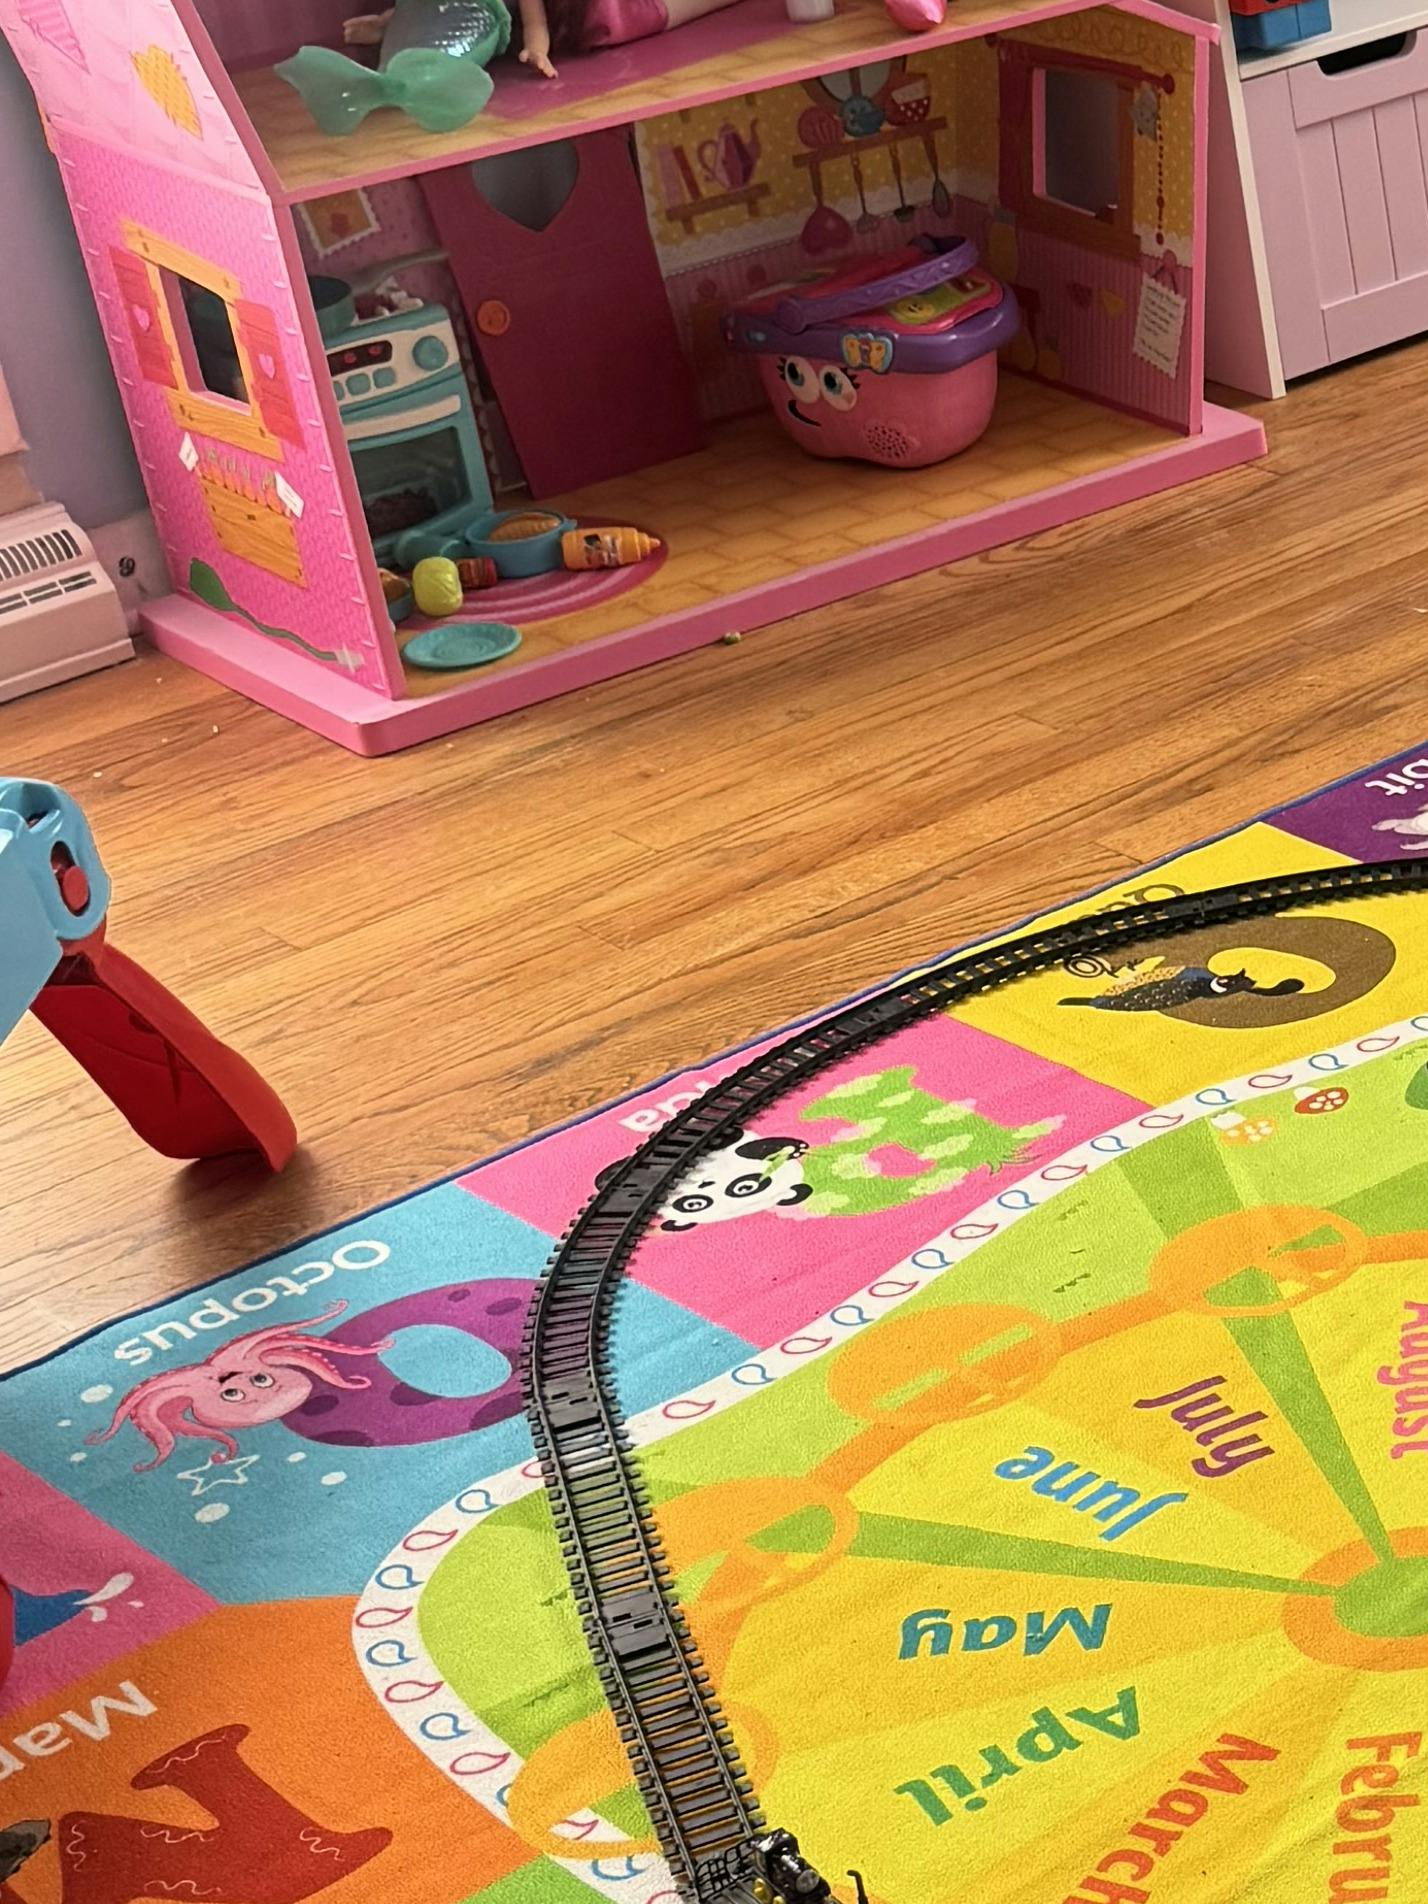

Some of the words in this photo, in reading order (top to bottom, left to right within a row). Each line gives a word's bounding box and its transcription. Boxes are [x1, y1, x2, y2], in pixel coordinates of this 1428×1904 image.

[112, 1238, 389, 1367] Octopus
[1134, 1374, 1278, 1478] July
[991, 1444, 1188, 1539] June
[898, 1603, 1113, 1662] May
[893, 1686, 1142, 1829] April
